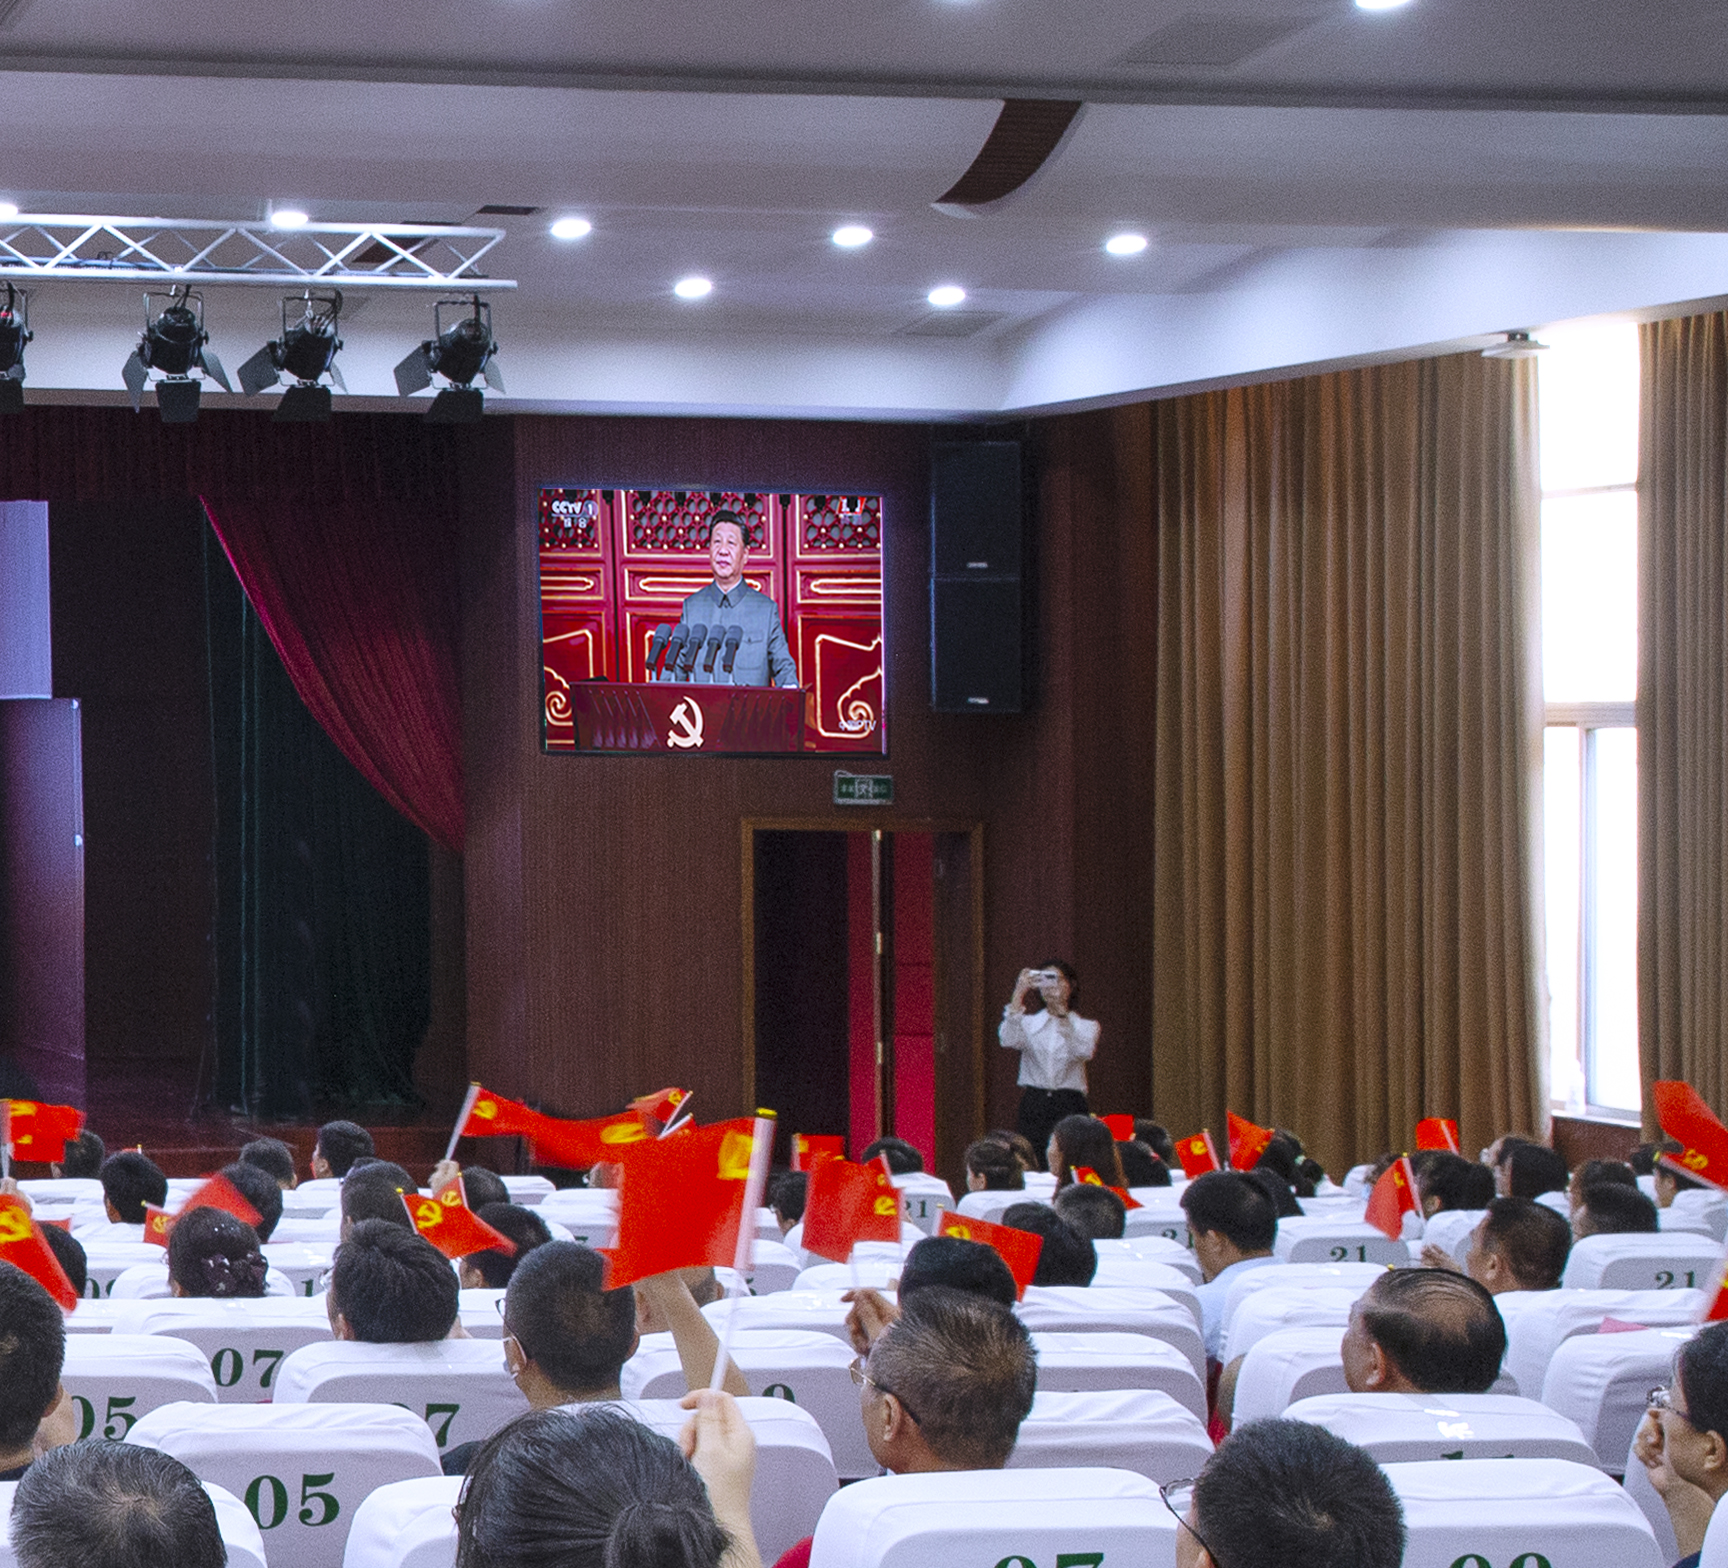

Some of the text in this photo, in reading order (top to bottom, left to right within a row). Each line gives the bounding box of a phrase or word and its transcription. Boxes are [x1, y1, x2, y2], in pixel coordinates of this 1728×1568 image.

[1330, 1245, 1365, 1263] 21
[1655, 1270, 1694, 1290] 21
[211, 1348, 284, 1388] 07
[71, 1395, 138, 1442] 05
[244, 1472, 341, 1530] 05
